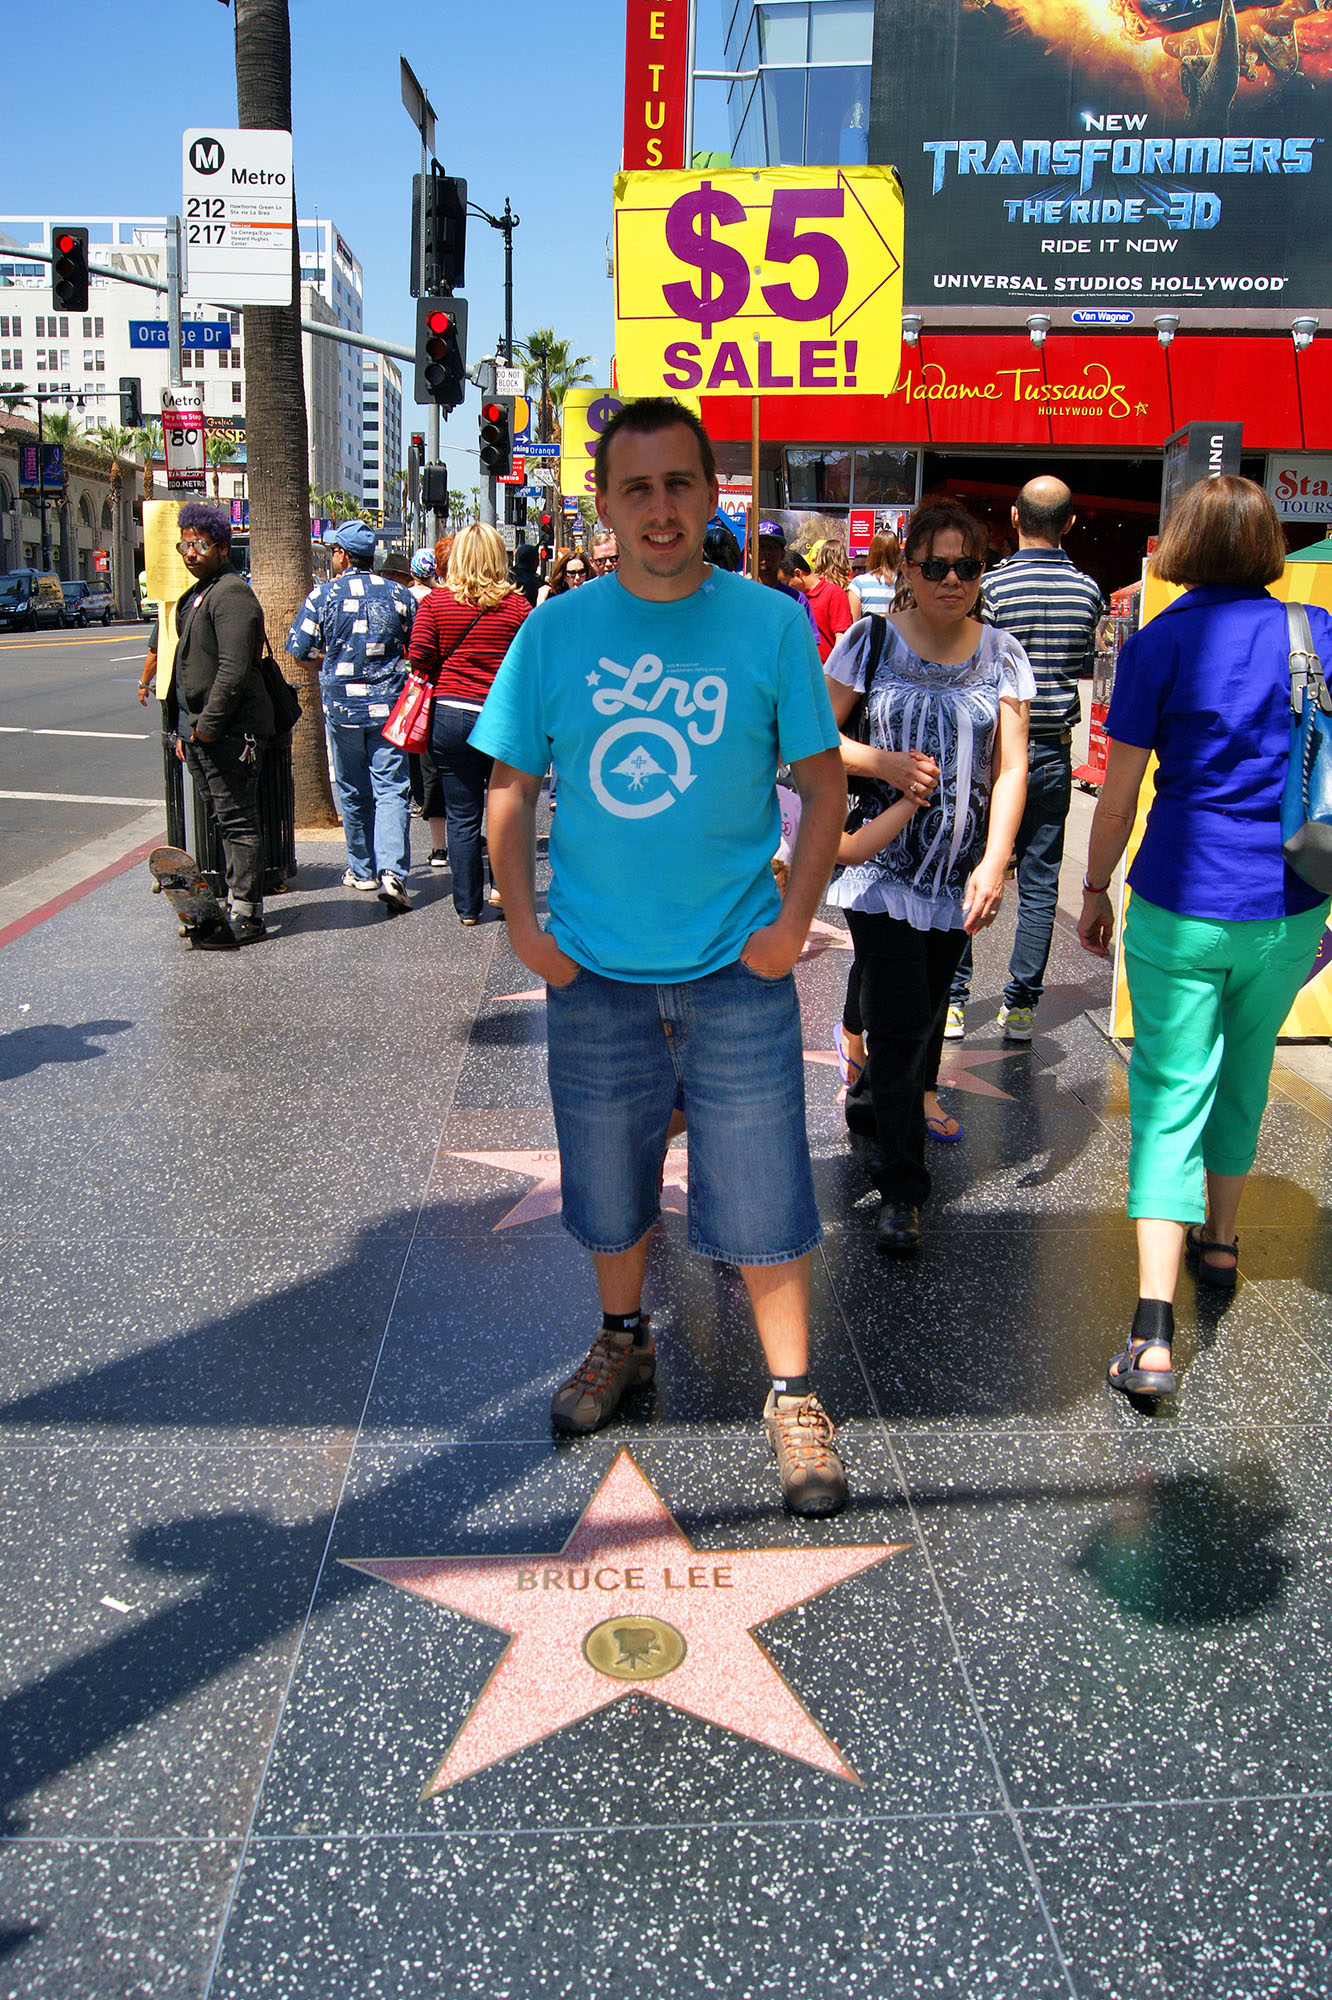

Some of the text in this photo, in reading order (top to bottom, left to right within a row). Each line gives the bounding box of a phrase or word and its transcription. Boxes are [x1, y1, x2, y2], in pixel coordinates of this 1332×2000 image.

[1085, 114, 1148, 132] NEW
[923, 137, 1316, 196] TRANSFORMERS
[231, 168, 286, 185] Metro
[187, 198, 225, 218] 212
[1003, 199, 1066, 224] THE
[189, 225, 226, 244] 217
[1041, 239, 1179, 253] RIDE IT NOW
[662, 181, 849, 340] $5
[933, 274, 1285, 292] UNIVERSAL STUDIOS HOLLYWOOD
[1080, 311, 1131, 324] Van Wagner
[138, 326, 223, 346] Orage Dr
[663, 340, 858, 390] SALE!
[498, 379, 519, 387] BLOCK
[508, 371, 520, 379] NOT
[996, 363, 1131, 419] Tussauds
[188, 413, 202, 421] Stop
[1038, 406, 1103, 416] HOLLYWOOD
[170, 428, 198, 447] 80
[530, 446, 556, 456] Orange
[1275, 469, 1332, 500] Sta
[517, 1566, 734, 1591] BRUCE LEE
